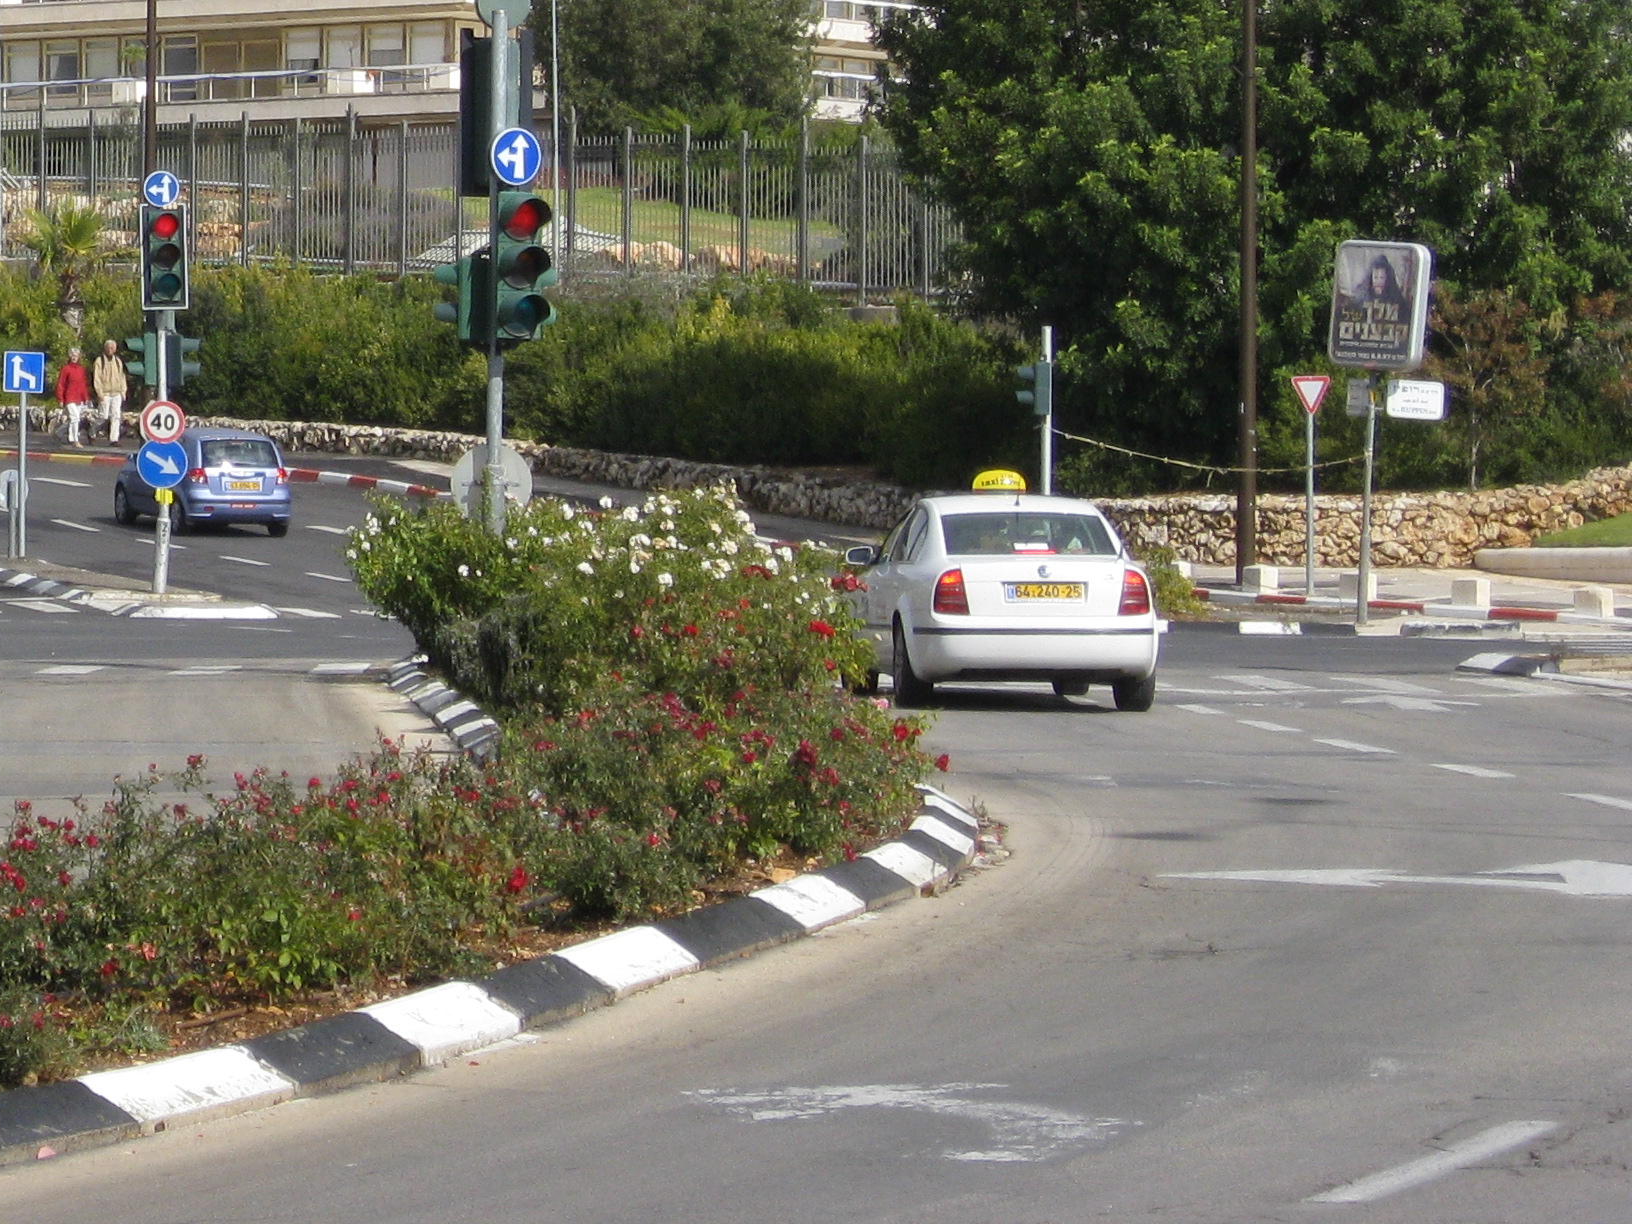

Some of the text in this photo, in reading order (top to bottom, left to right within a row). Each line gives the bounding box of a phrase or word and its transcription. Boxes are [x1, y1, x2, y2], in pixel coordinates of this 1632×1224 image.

[1363, 299, 1400, 324] מלך
[1339, 322, 1409, 348] קבצנים
[150, 413, 175, 431] 40
[981, 477, 999, 487] taxi
